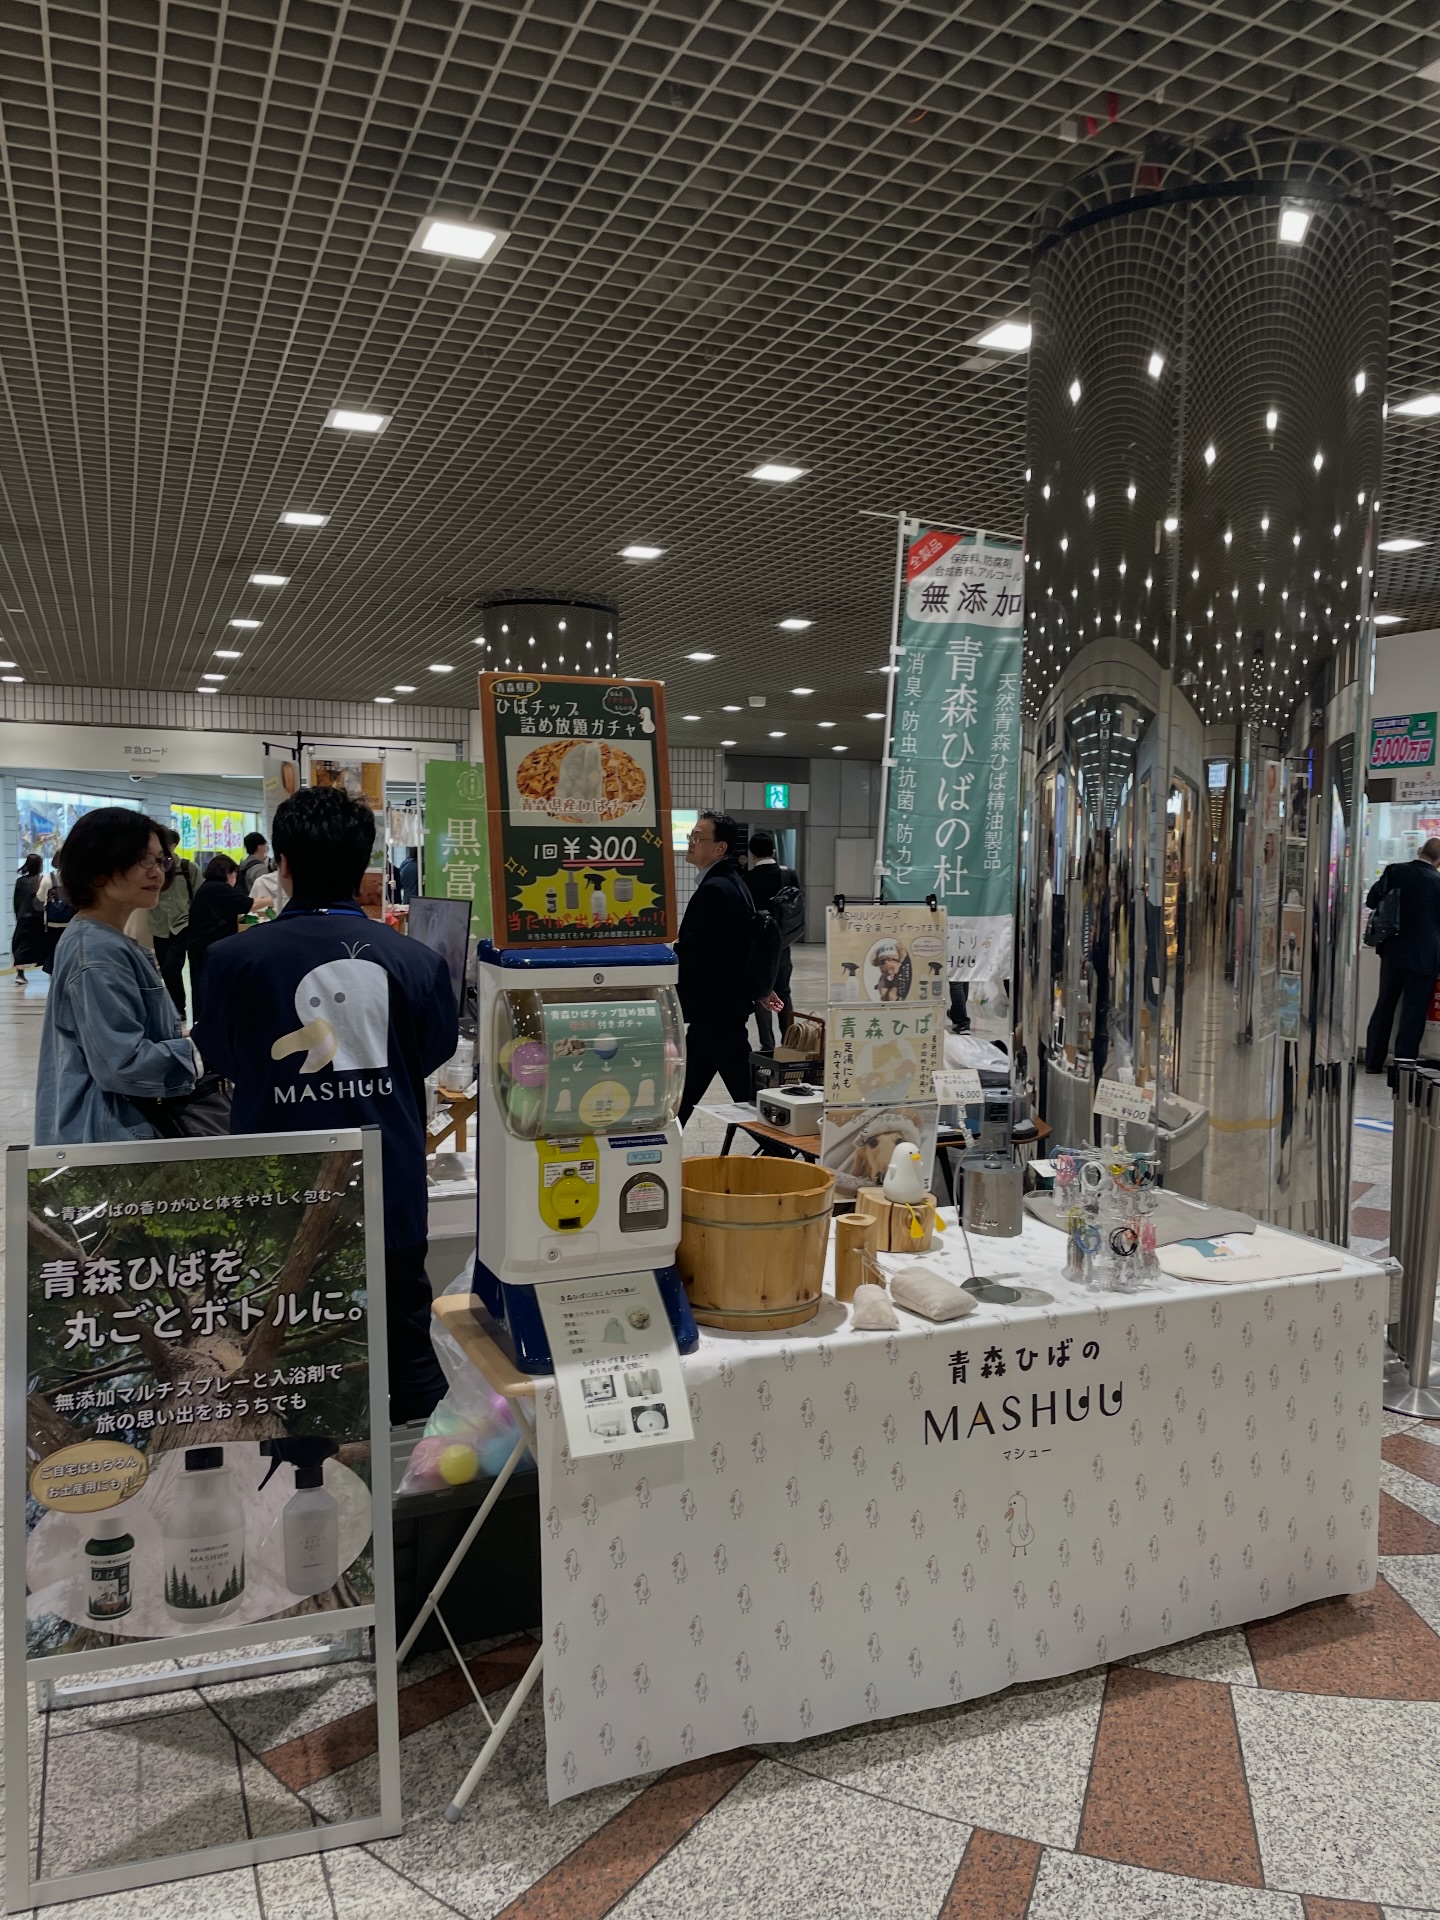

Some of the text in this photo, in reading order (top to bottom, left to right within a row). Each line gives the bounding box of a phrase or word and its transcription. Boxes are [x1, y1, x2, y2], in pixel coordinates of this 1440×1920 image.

[909, 538, 943, 570] 全製品
[920, 581, 1022, 617] 無添加
[496, 698, 579, 716] ひばチップ
[520, 716, 637, 737] 詰め放題ガチャ
[124, 745, 168, 756] 京急ロード
[932, 635, 983, 898] 青森ひばの杜
[1371, 735, 1432, 766] 5,000万円
[896, 652, 925, 885] 消臭・防虫・抗菌・防カビ
[984, 673, 1018, 869] 天然青森ひば精油製品
[520, 798, 647, 815] 青森県産ひばチップ
[562, 836, 638, 861] ¥300
[841, 1013, 933, 1039] 青森ひば
[274, 1077, 393, 1104] MASHUU
[40, 1248, 262, 1299] 青森ひばを、
[63, 1290, 363, 1350] 丸ごとボトルに。
[948, 1337, 1101, 1385] 青森ひばの
[54, 1364, 343, 1412] 無添加マルチスプレーと入浴剤で
[96, 1393, 307, 1433] 旅の思い出をおうちでも
[924, 1380, 1123, 1446] MASHUU
[41, 1456, 138, 1479] ご自宅はもちろん
[1003, 1448, 1052, 1461] マシュー
